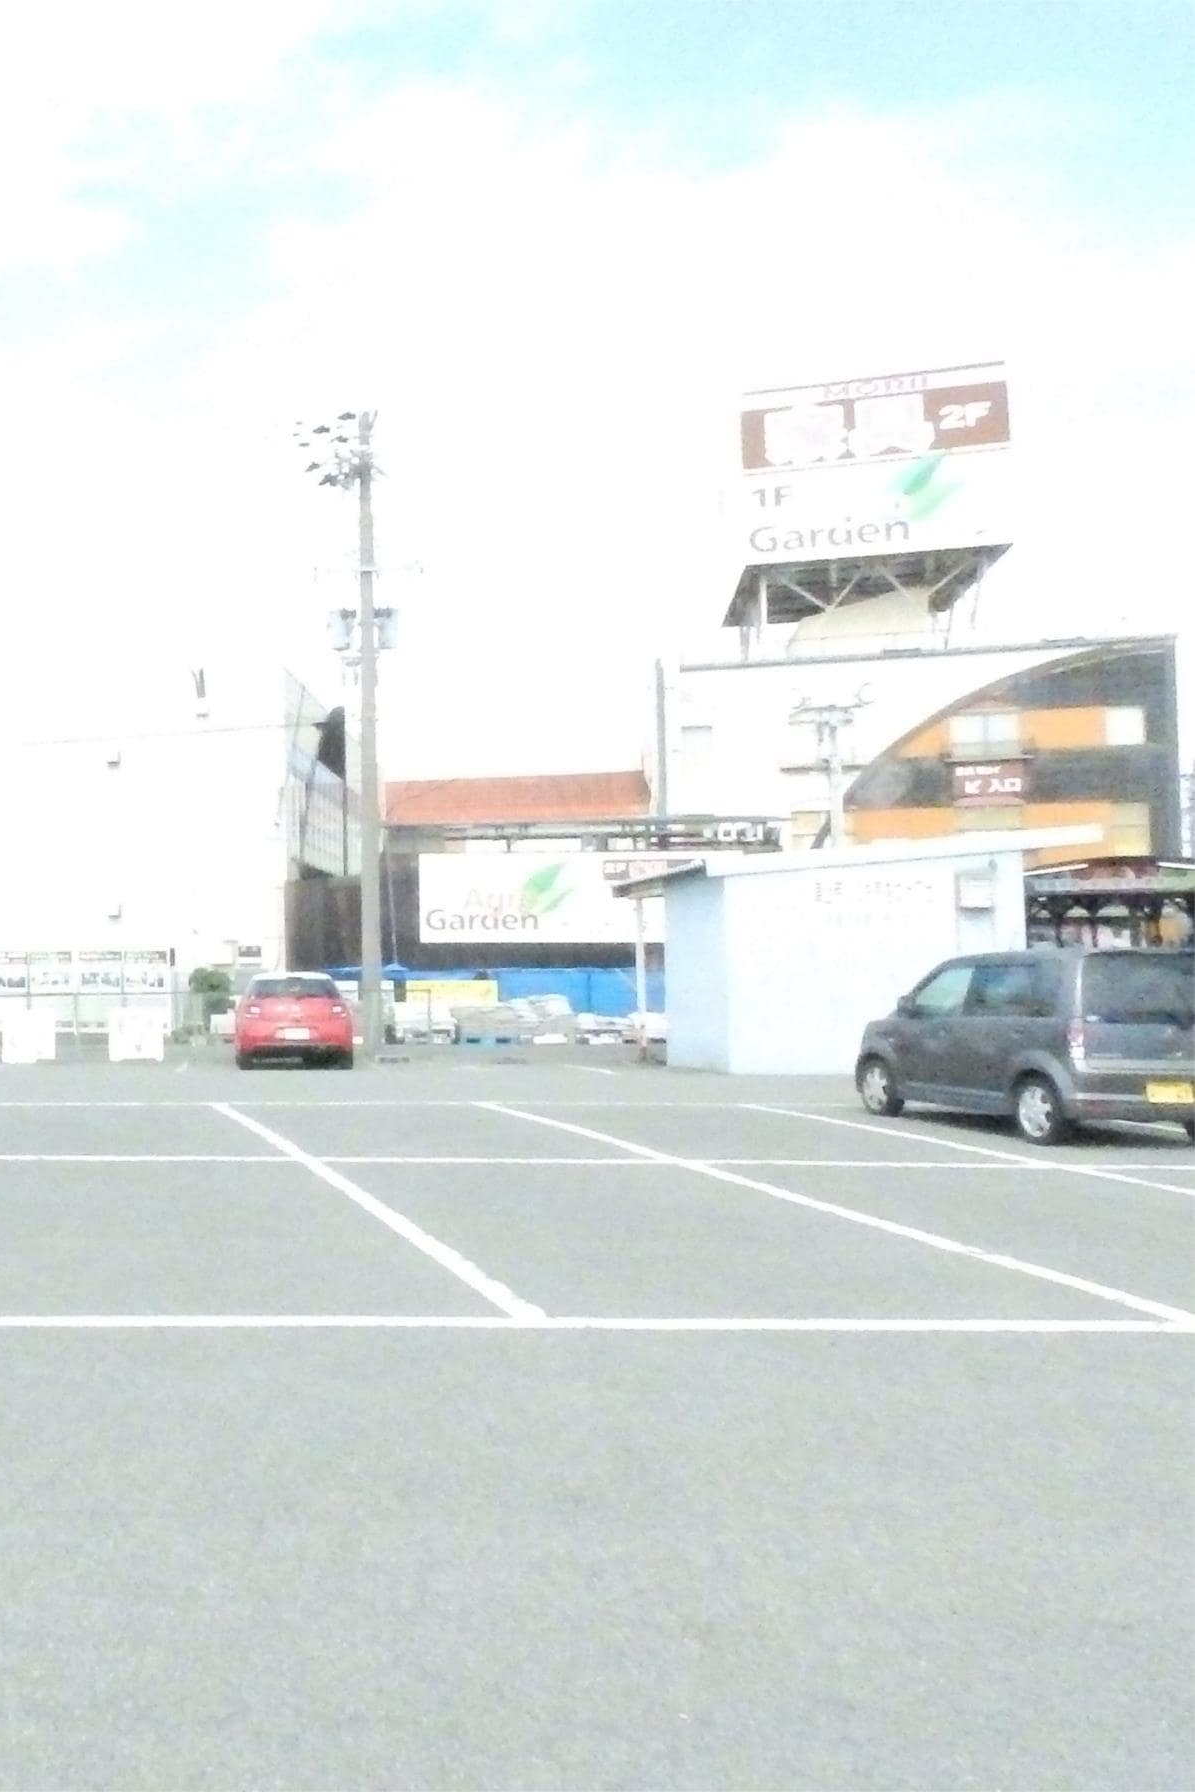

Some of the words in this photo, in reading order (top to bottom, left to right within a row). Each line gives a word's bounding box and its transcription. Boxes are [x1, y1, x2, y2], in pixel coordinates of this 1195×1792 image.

[939, 402, 991, 430] 2F
[752, 486, 792, 507] 1F
[426, 907, 539, 931] Garden
